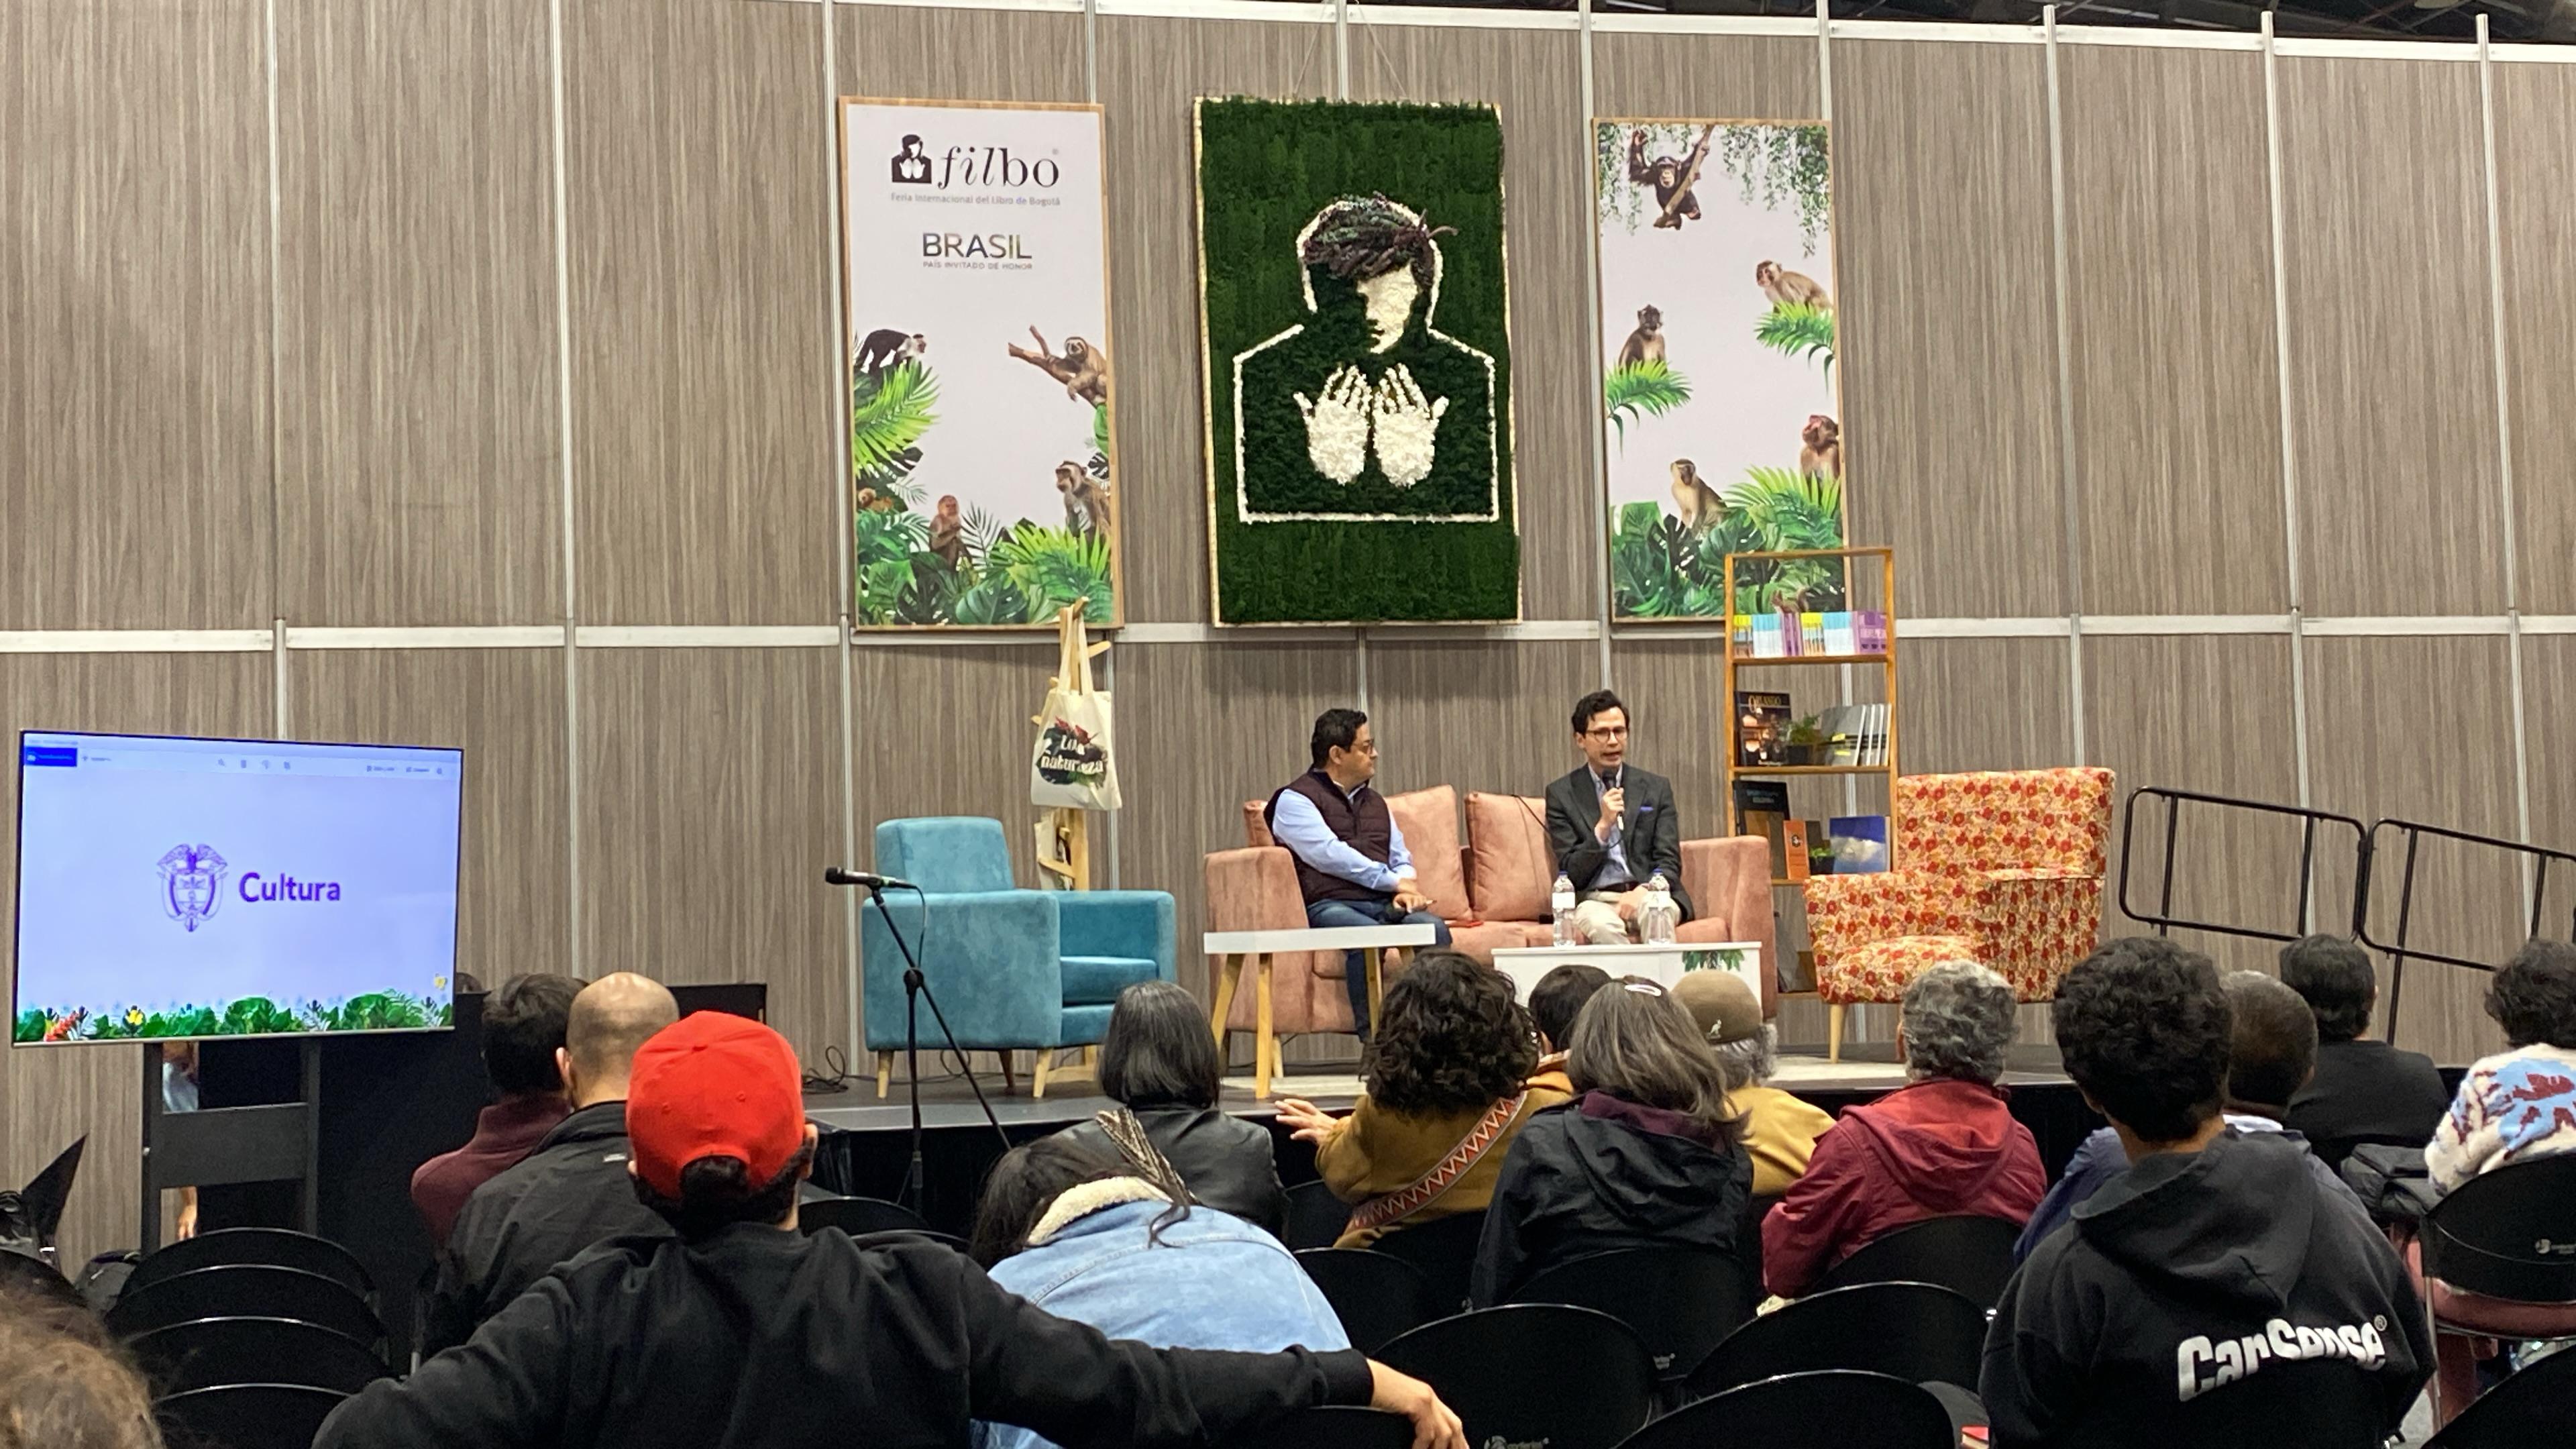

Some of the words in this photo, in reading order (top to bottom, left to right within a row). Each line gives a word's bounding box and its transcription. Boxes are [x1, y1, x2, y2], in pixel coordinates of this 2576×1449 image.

[938, 146, 1059, 189] filbo
[891, 193, 912, 202] Feria
[915, 194, 973, 204] Internacional
[975, 195, 989, 204] del
[991, 196, 1014, 205] Libro
[1016, 196, 1027, 205] de
[1029, 197, 1061, 207] Bogotá
[922, 233, 1032, 259] BRASIL
[944, 261, 985, 269] INVITADO
[1002, 262, 1032, 270] HONOR
[239, 871, 341, 903] Cultura
